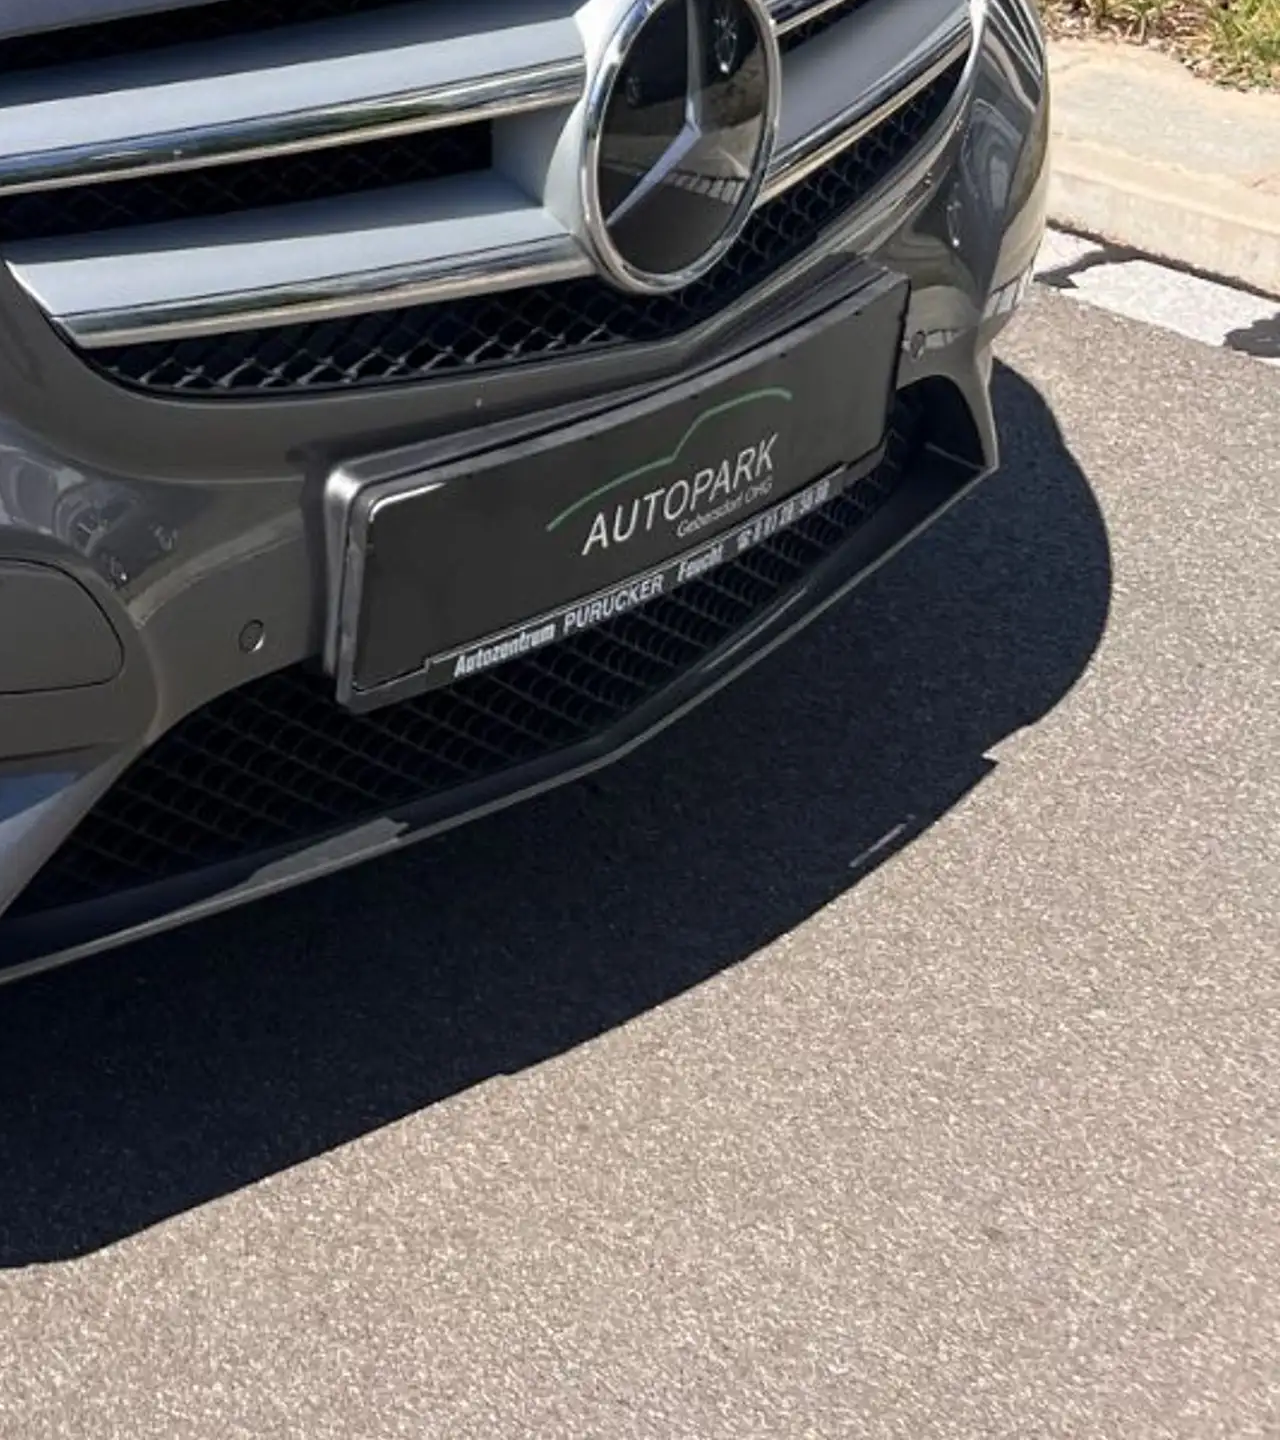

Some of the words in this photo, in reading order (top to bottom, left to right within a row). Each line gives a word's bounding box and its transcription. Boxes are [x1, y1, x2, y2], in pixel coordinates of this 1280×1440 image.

[581, 433, 779, 556] AUTOPARK
[454, 622, 556, 678] Autozentrum
[562, 573, 665, 636] PURUCKER
